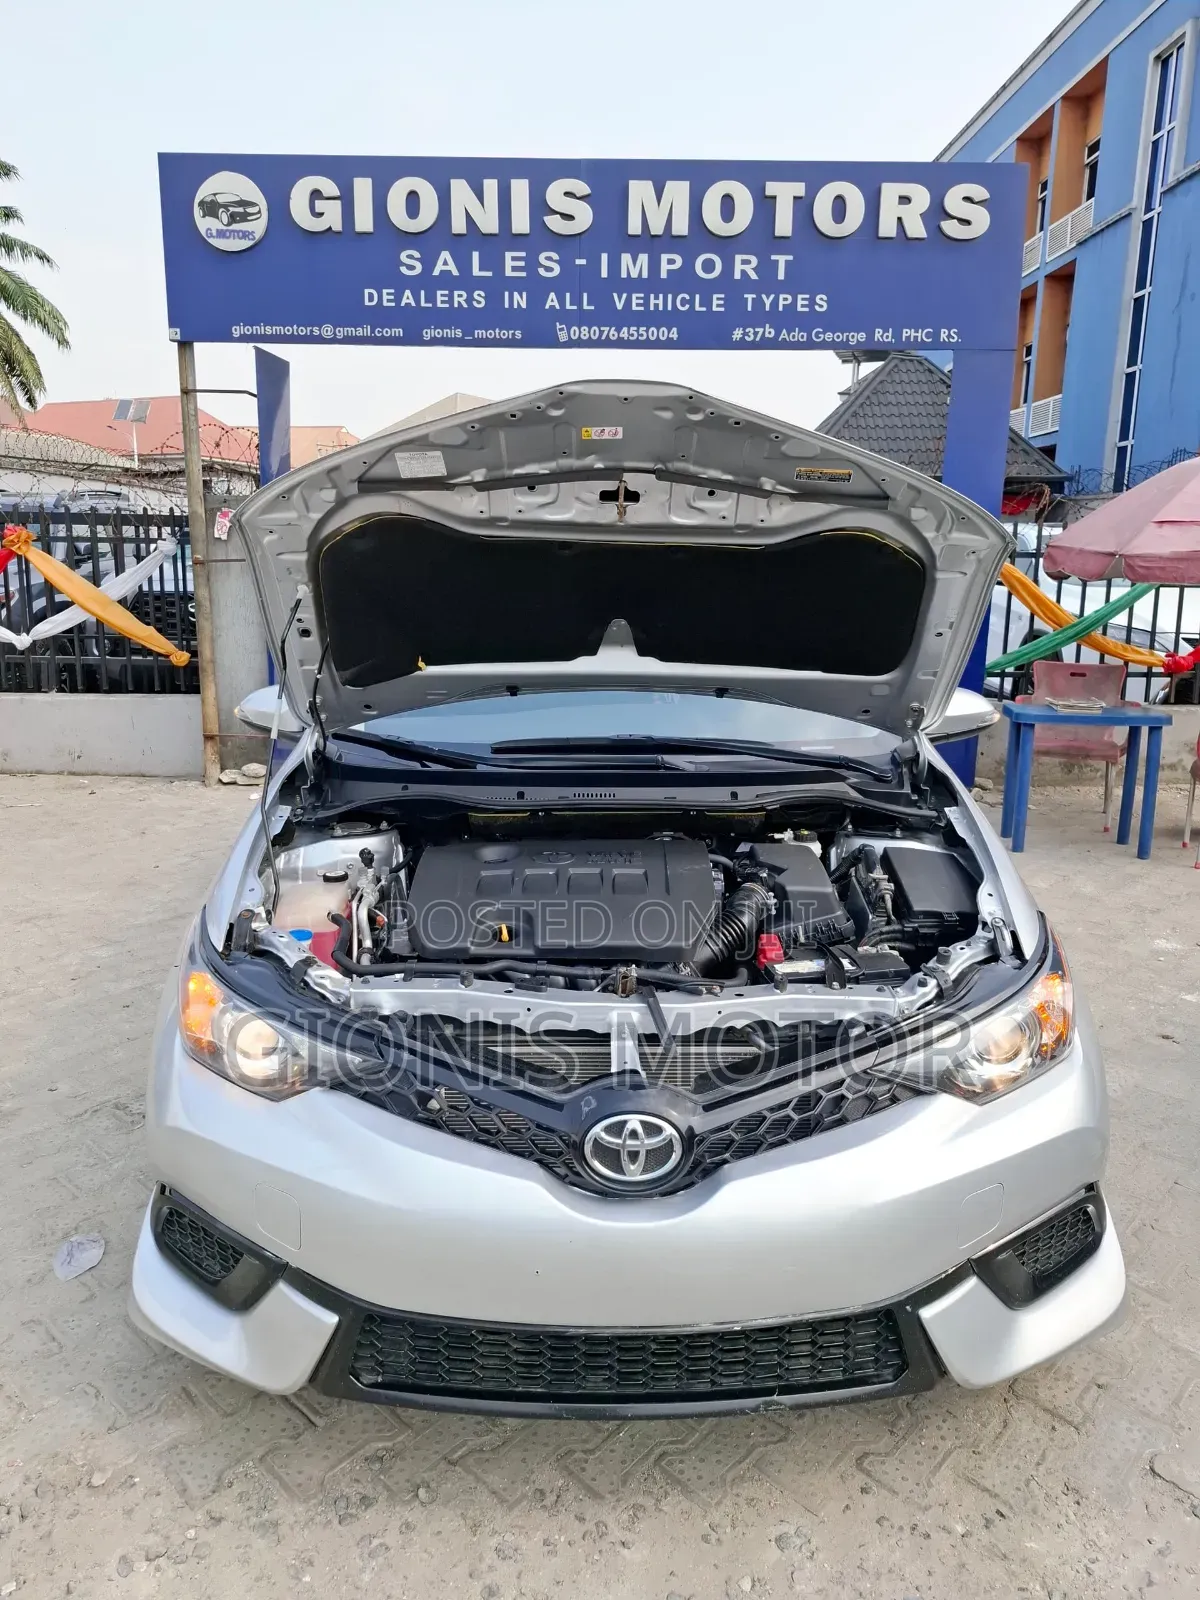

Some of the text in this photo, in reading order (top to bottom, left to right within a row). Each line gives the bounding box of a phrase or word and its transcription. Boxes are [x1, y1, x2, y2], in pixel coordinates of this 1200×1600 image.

[289, 175, 991, 240] GIONIS MOTORS
[205, 227, 256, 241] G.MOTORS
[363, 288, 828, 312] DEALERS IN ALL VEHICLE TYPES
[231, 323, 404, 339] gionismotors@gmail.com
[570, 326, 679, 341] 08076455004
[778, 327, 808, 342] Ada
[811, 327, 867, 346] George
[874, 327, 896, 346] Rd,
[902, 328, 934, 342] PHC
[939, 328, 962, 342] RS.
